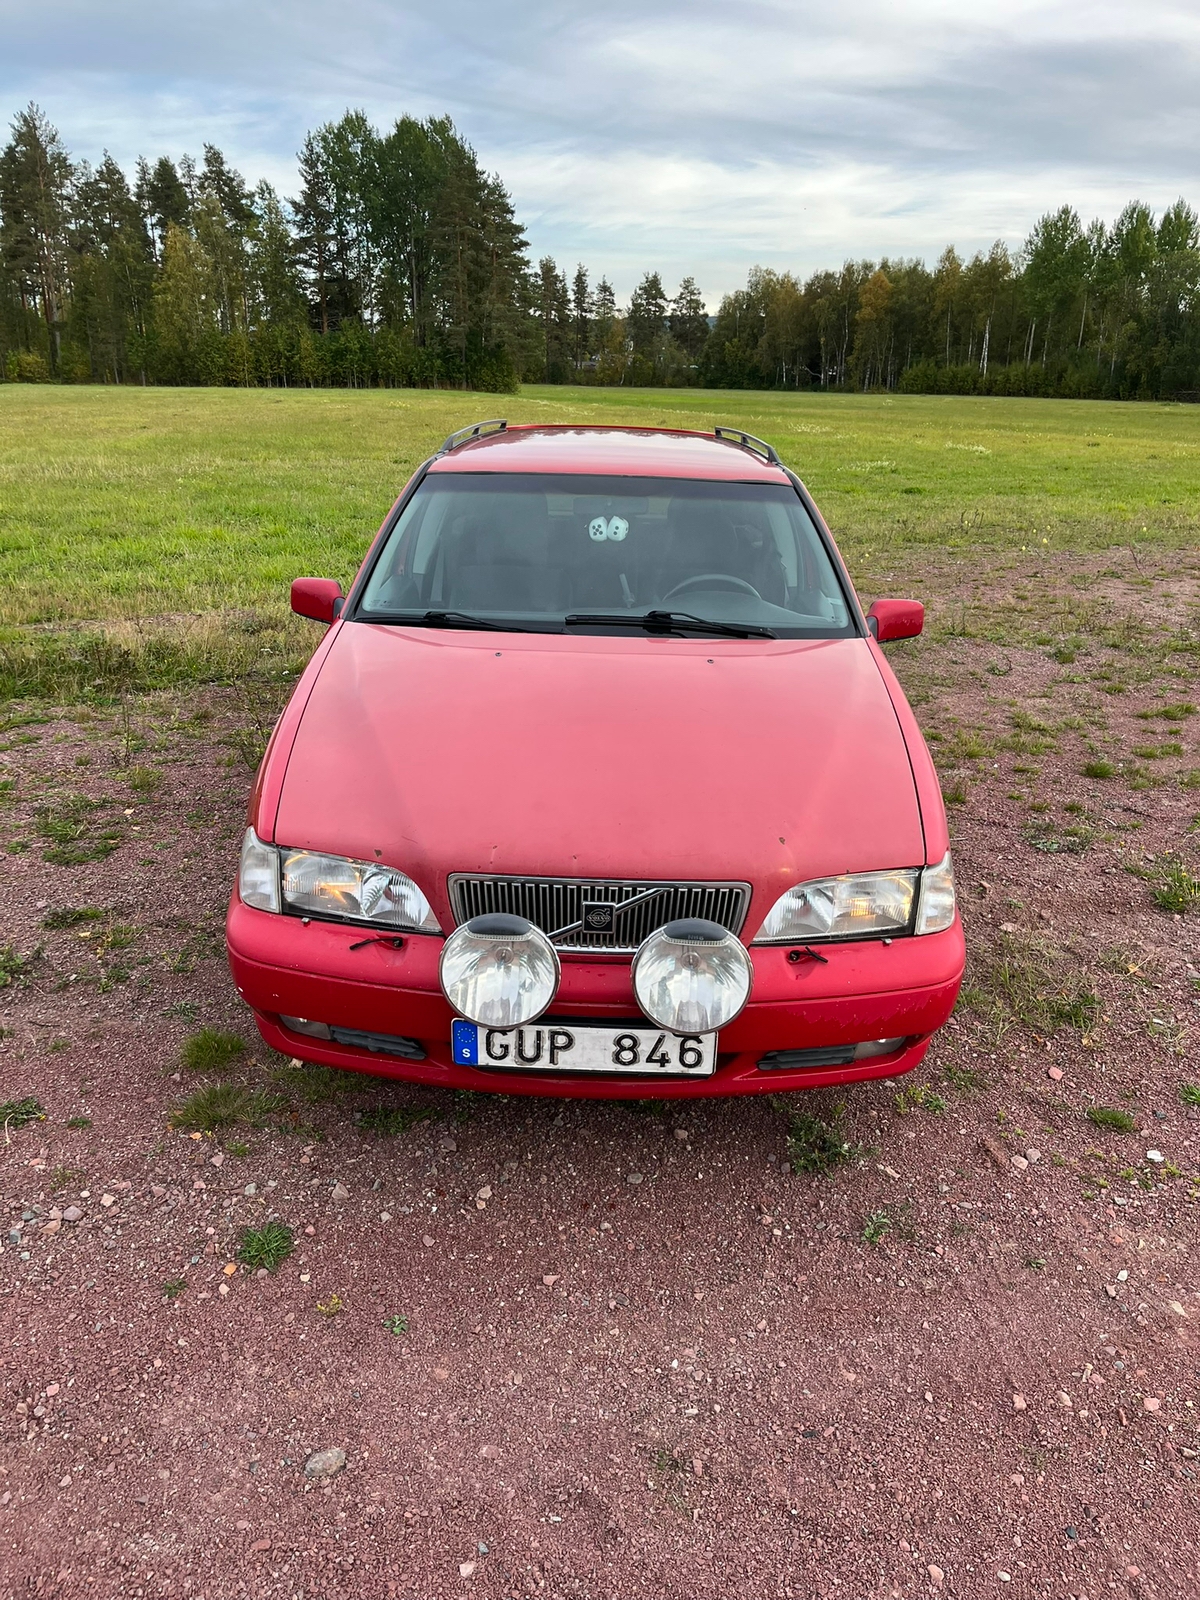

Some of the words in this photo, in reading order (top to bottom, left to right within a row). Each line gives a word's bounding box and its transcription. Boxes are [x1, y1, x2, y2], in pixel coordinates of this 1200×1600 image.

[462, 1048, 471, 1058] S
[485, 1029, 575, 1065] GUP
[612, 1033, 704, 1068] 846
